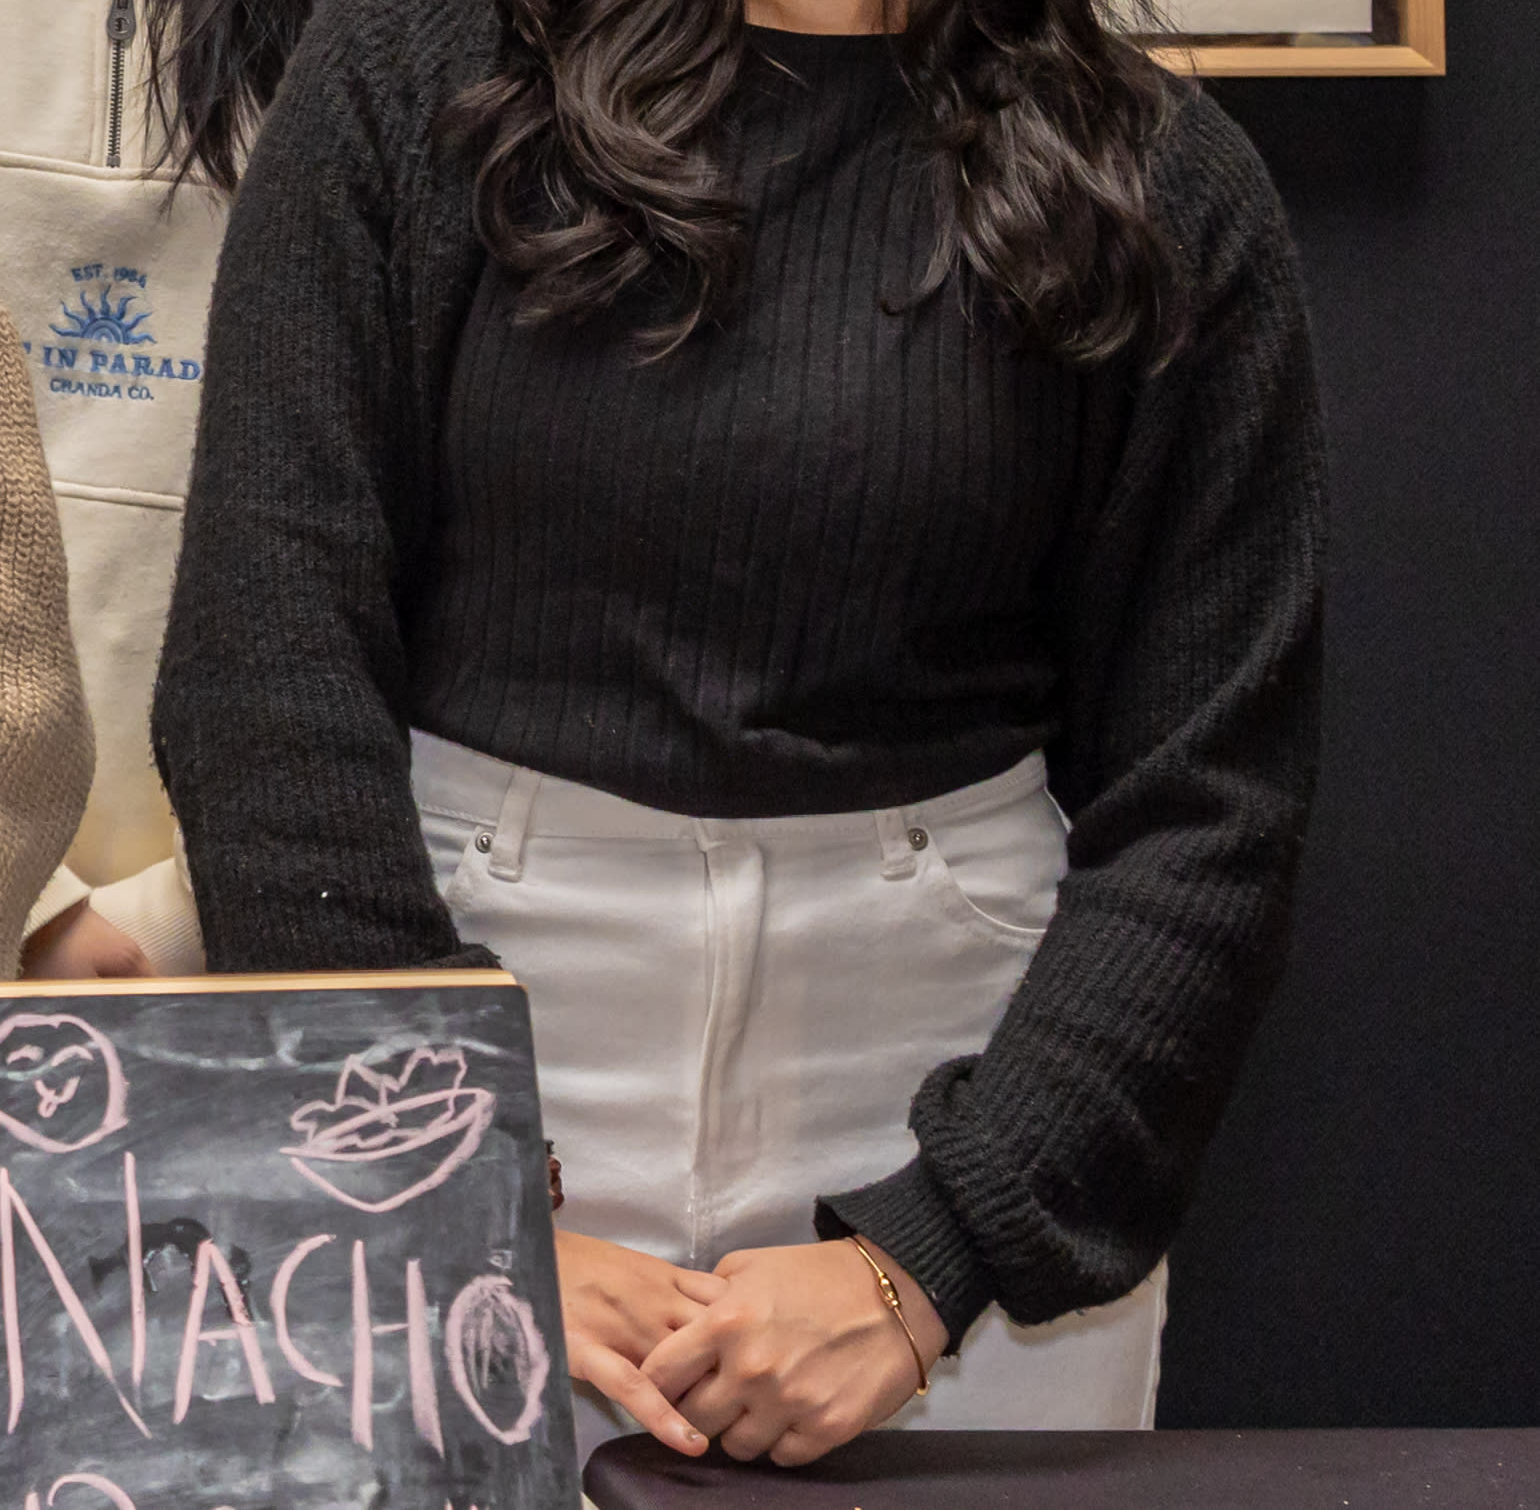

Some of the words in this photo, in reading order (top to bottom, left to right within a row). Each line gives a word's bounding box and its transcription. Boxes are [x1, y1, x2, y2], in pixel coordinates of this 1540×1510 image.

[43, 346, 79, 369] IN
[90, 349, 202, 381] PARAD
[128, 385, 155, 402] CO.
